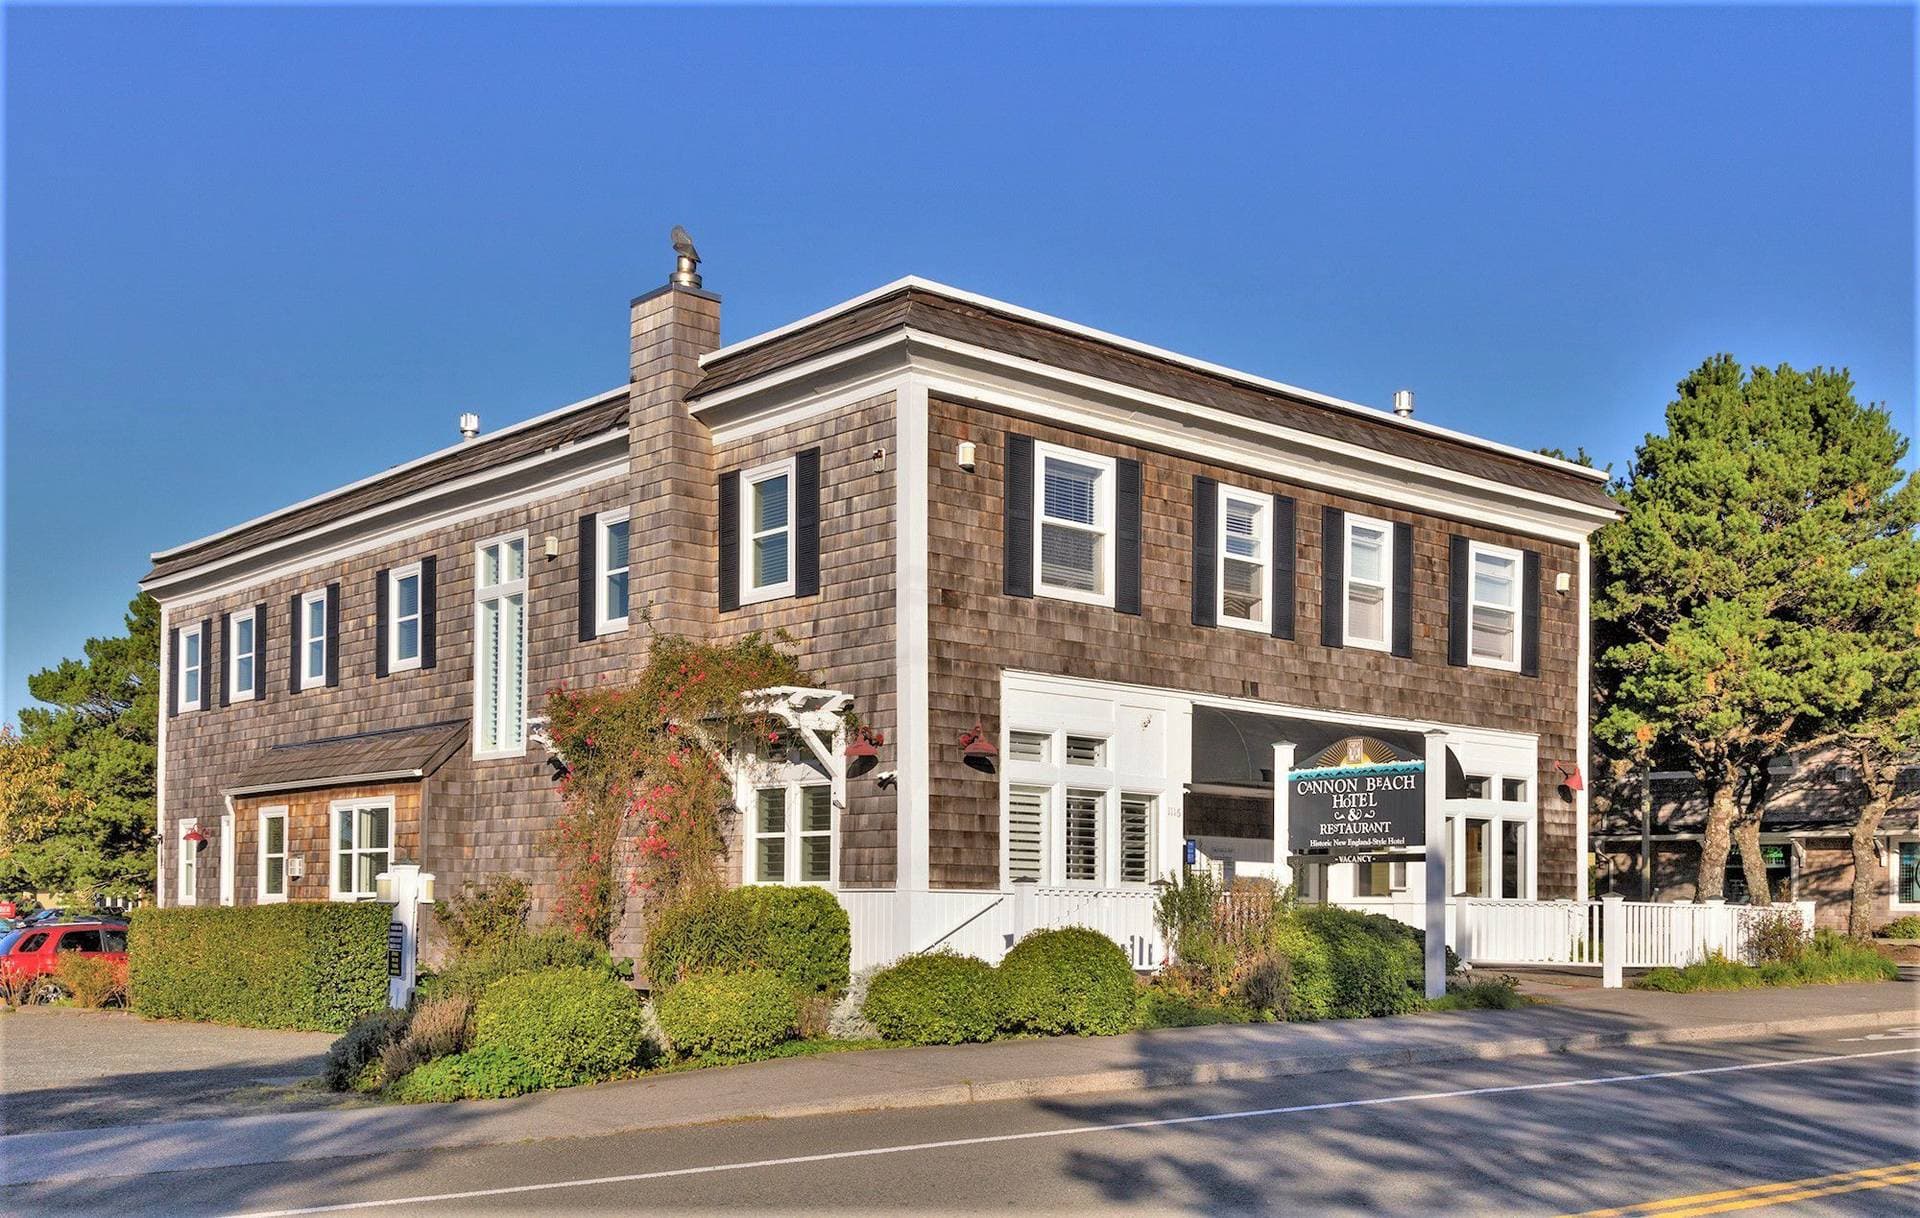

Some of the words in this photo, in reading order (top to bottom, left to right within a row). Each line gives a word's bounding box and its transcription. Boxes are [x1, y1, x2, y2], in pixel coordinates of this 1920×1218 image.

[1297, 778, 1357, 795] CANNON
[1366, 775, 1416, 791] BEACH
[1332, 792, 1377, 808] HOTEL
[1347, 808, 1362, 821] &
[1320, 822, 1391, 835] RESTAURANT
[1310, 839, 1332, 848] Historic
[1333, 838, 1346, 847] New
[1347, 837, 1387, 848] England-Style
[1387, 836, 1405, 846] Hotel
